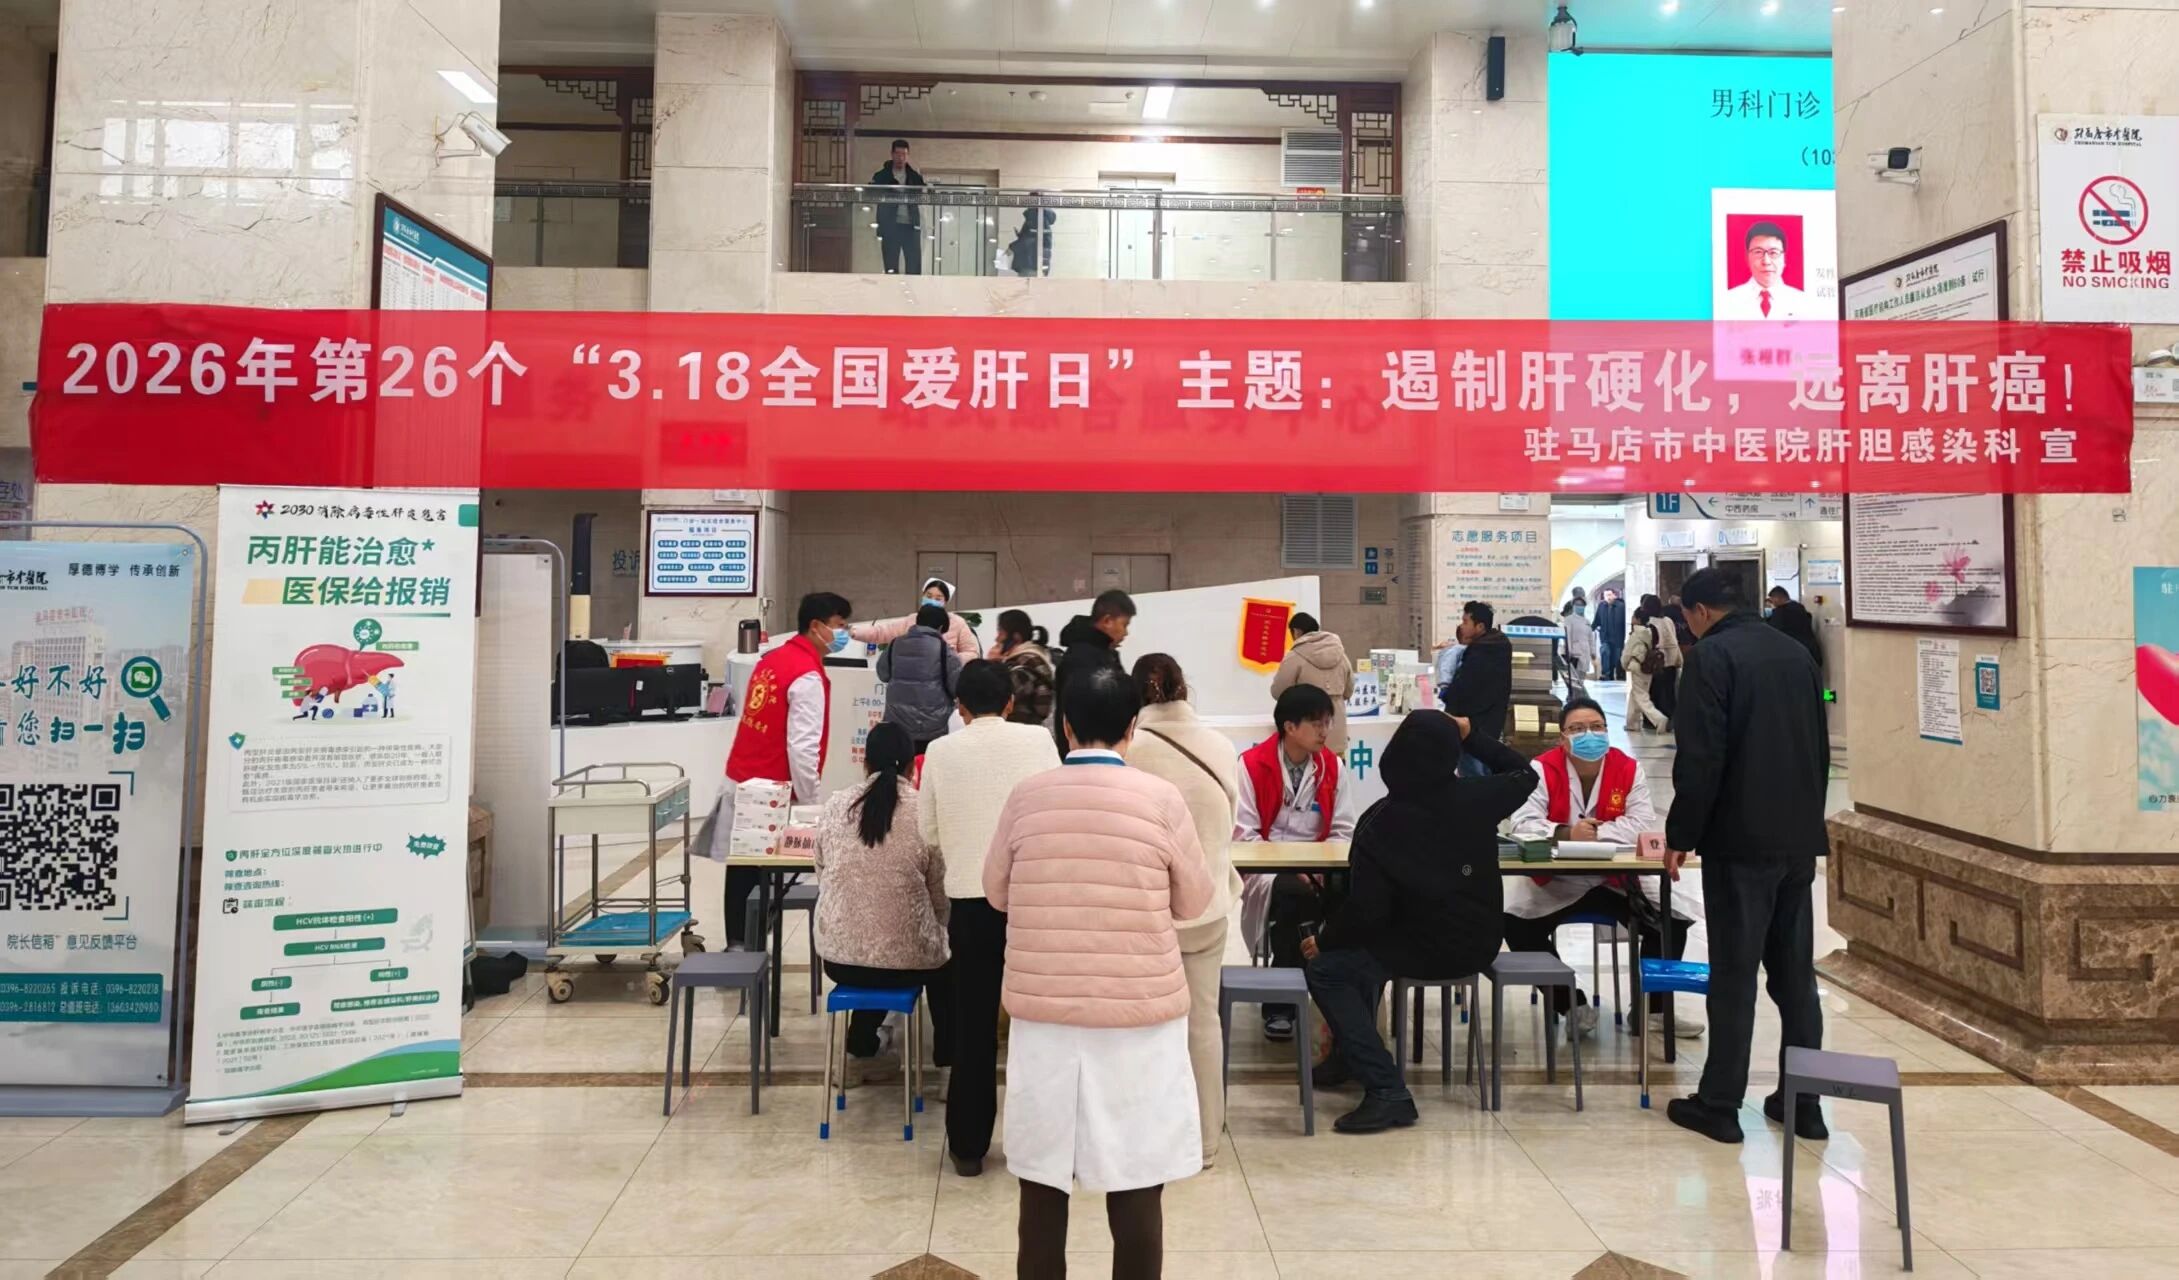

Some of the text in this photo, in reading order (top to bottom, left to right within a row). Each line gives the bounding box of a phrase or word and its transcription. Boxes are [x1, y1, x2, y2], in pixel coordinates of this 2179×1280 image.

[1710, 88, 1821, 119] 男科门诊
[1801, 146, 1836, 166] (10
[2061, 249, 2171, 276] 禁止吸烟
[2062, 276, 2170, 289] NO SMOKING
[1524, 427, 2078, 465] 驻马店市中医院肝胆感染科 宣
[1452, 530, 1538, 543] 志愿服务项目
[67, 562, 181, 577] 厚德博学 传承创新
[282, 575, 452, 607] 医保给报销
[0, 664, 108, 700] 好不好
[0, 710, 147, 755] 您扫一扫
[1350, 740, 1373, 780] 中
